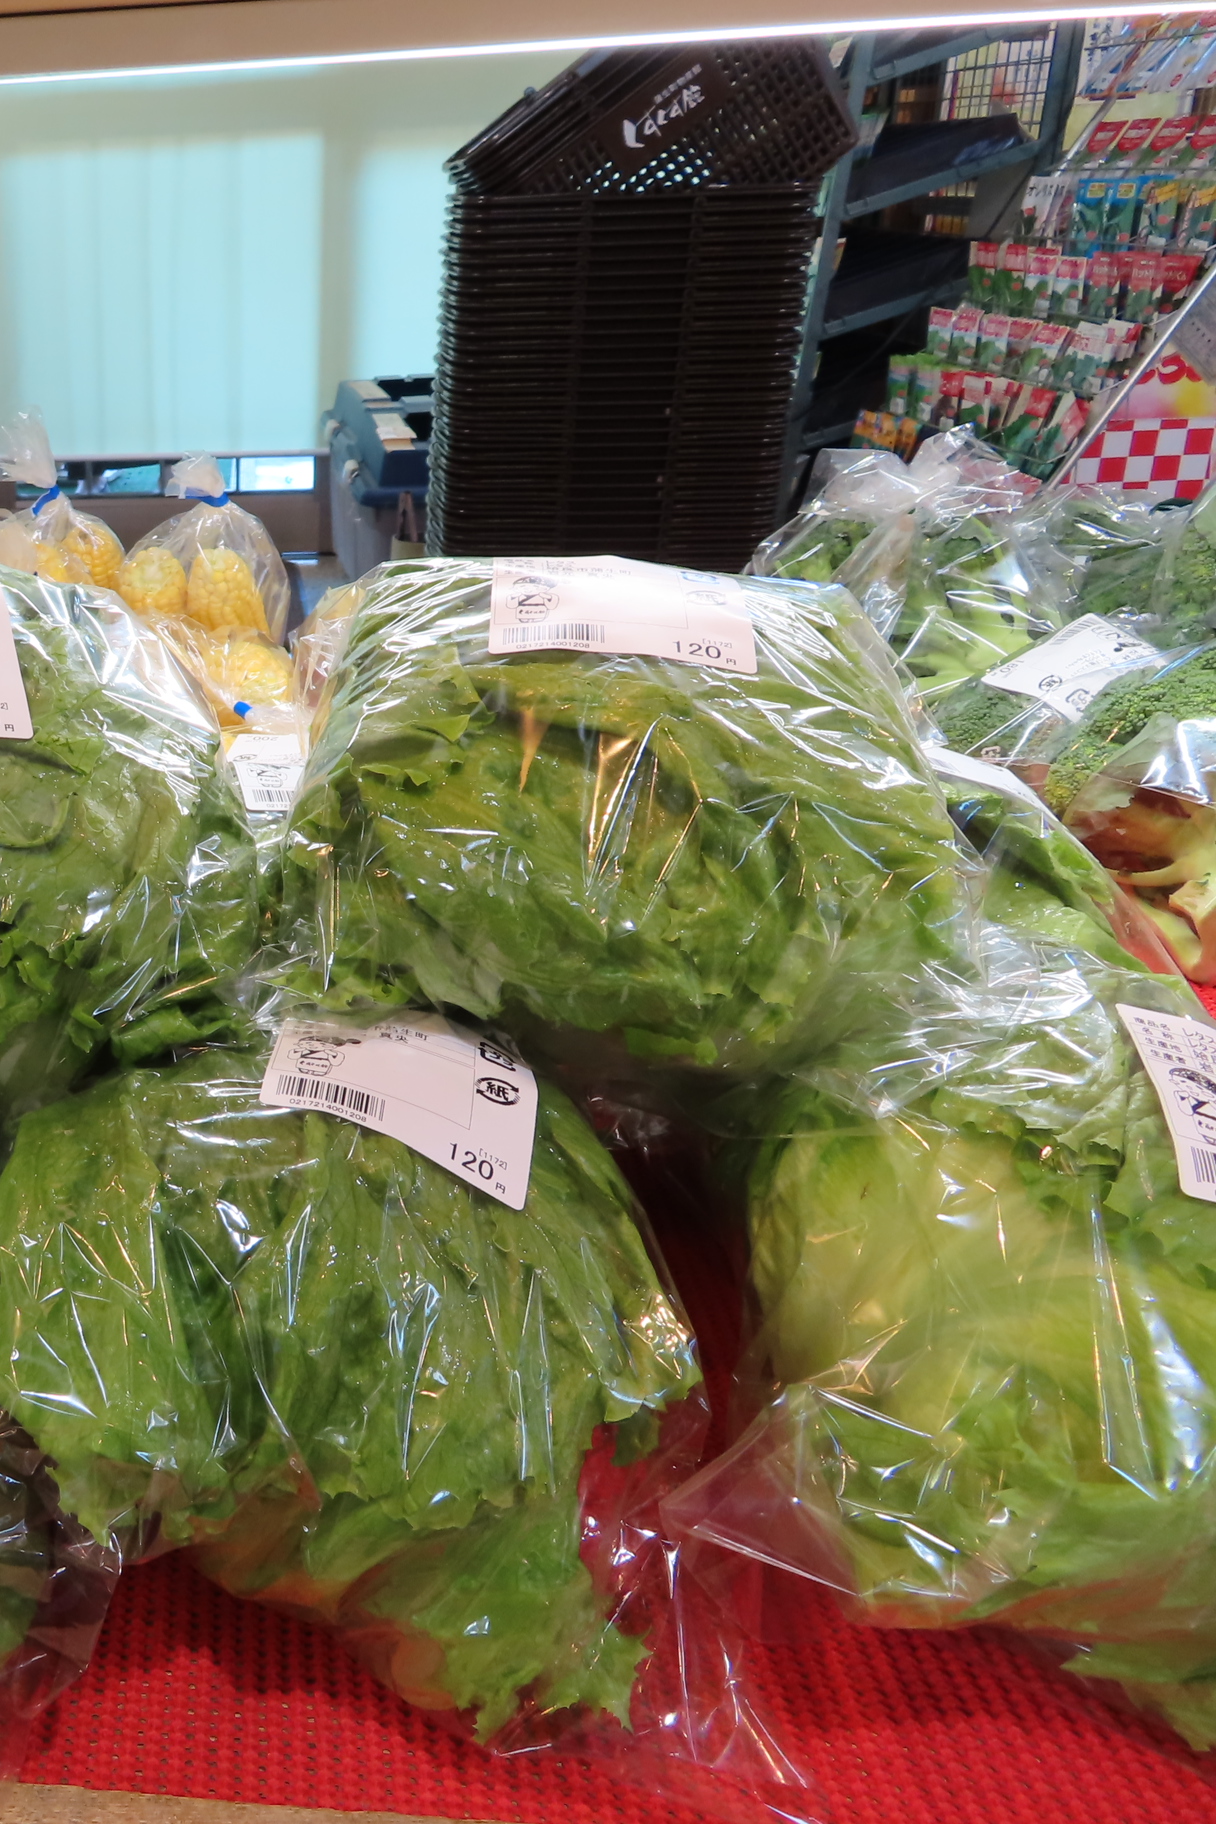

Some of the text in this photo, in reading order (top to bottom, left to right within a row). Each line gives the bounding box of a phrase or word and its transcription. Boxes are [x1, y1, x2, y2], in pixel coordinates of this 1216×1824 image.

[515, 641, 590, 650] 0217214001208
[486, 1081, 510, 1101] 紙
[289, 1098, 367, 1123] 0217214001208
[479, 1148, 508, 1171] [1172]
